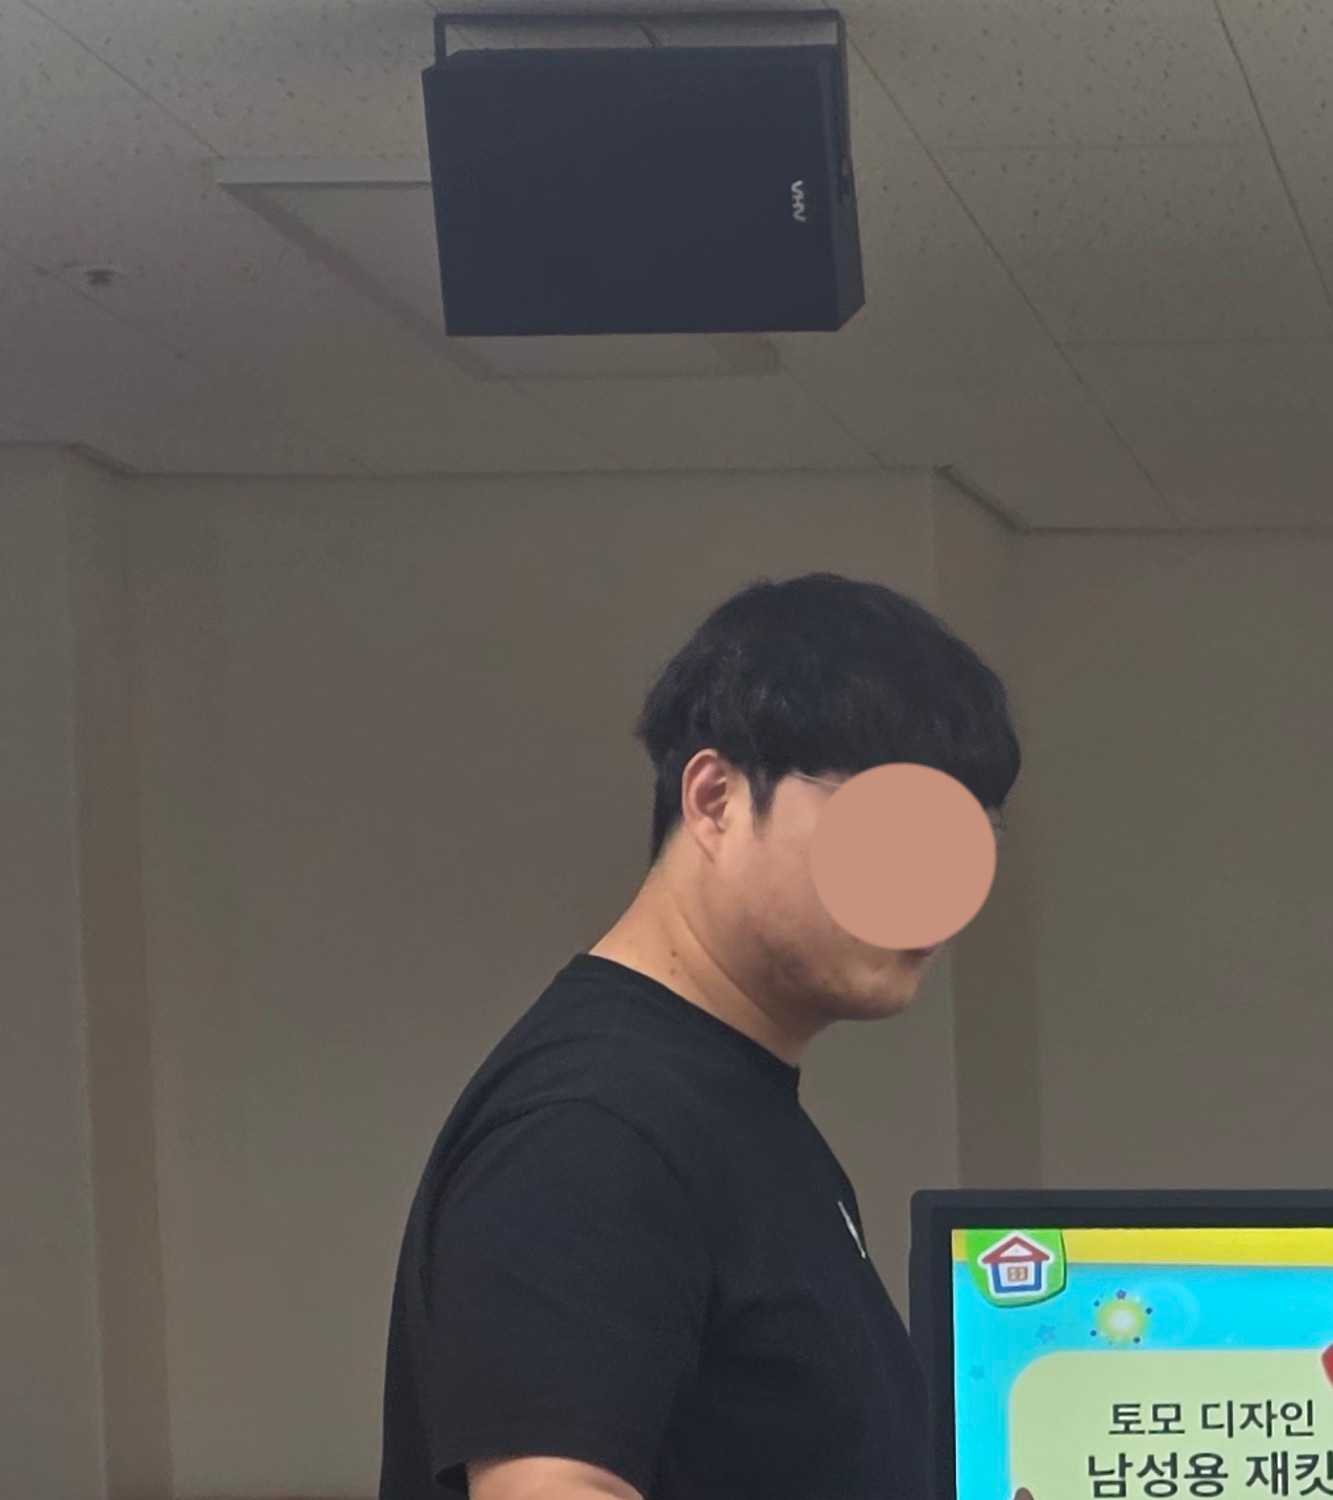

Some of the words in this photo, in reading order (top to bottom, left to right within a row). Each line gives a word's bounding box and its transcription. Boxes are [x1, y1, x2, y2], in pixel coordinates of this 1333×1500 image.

[1108, 1402, 1186, 1437] 토모
[1200, 1399, 1316, 1439] 디자인
[1086, 1452, 1229, 1499] 남성용
